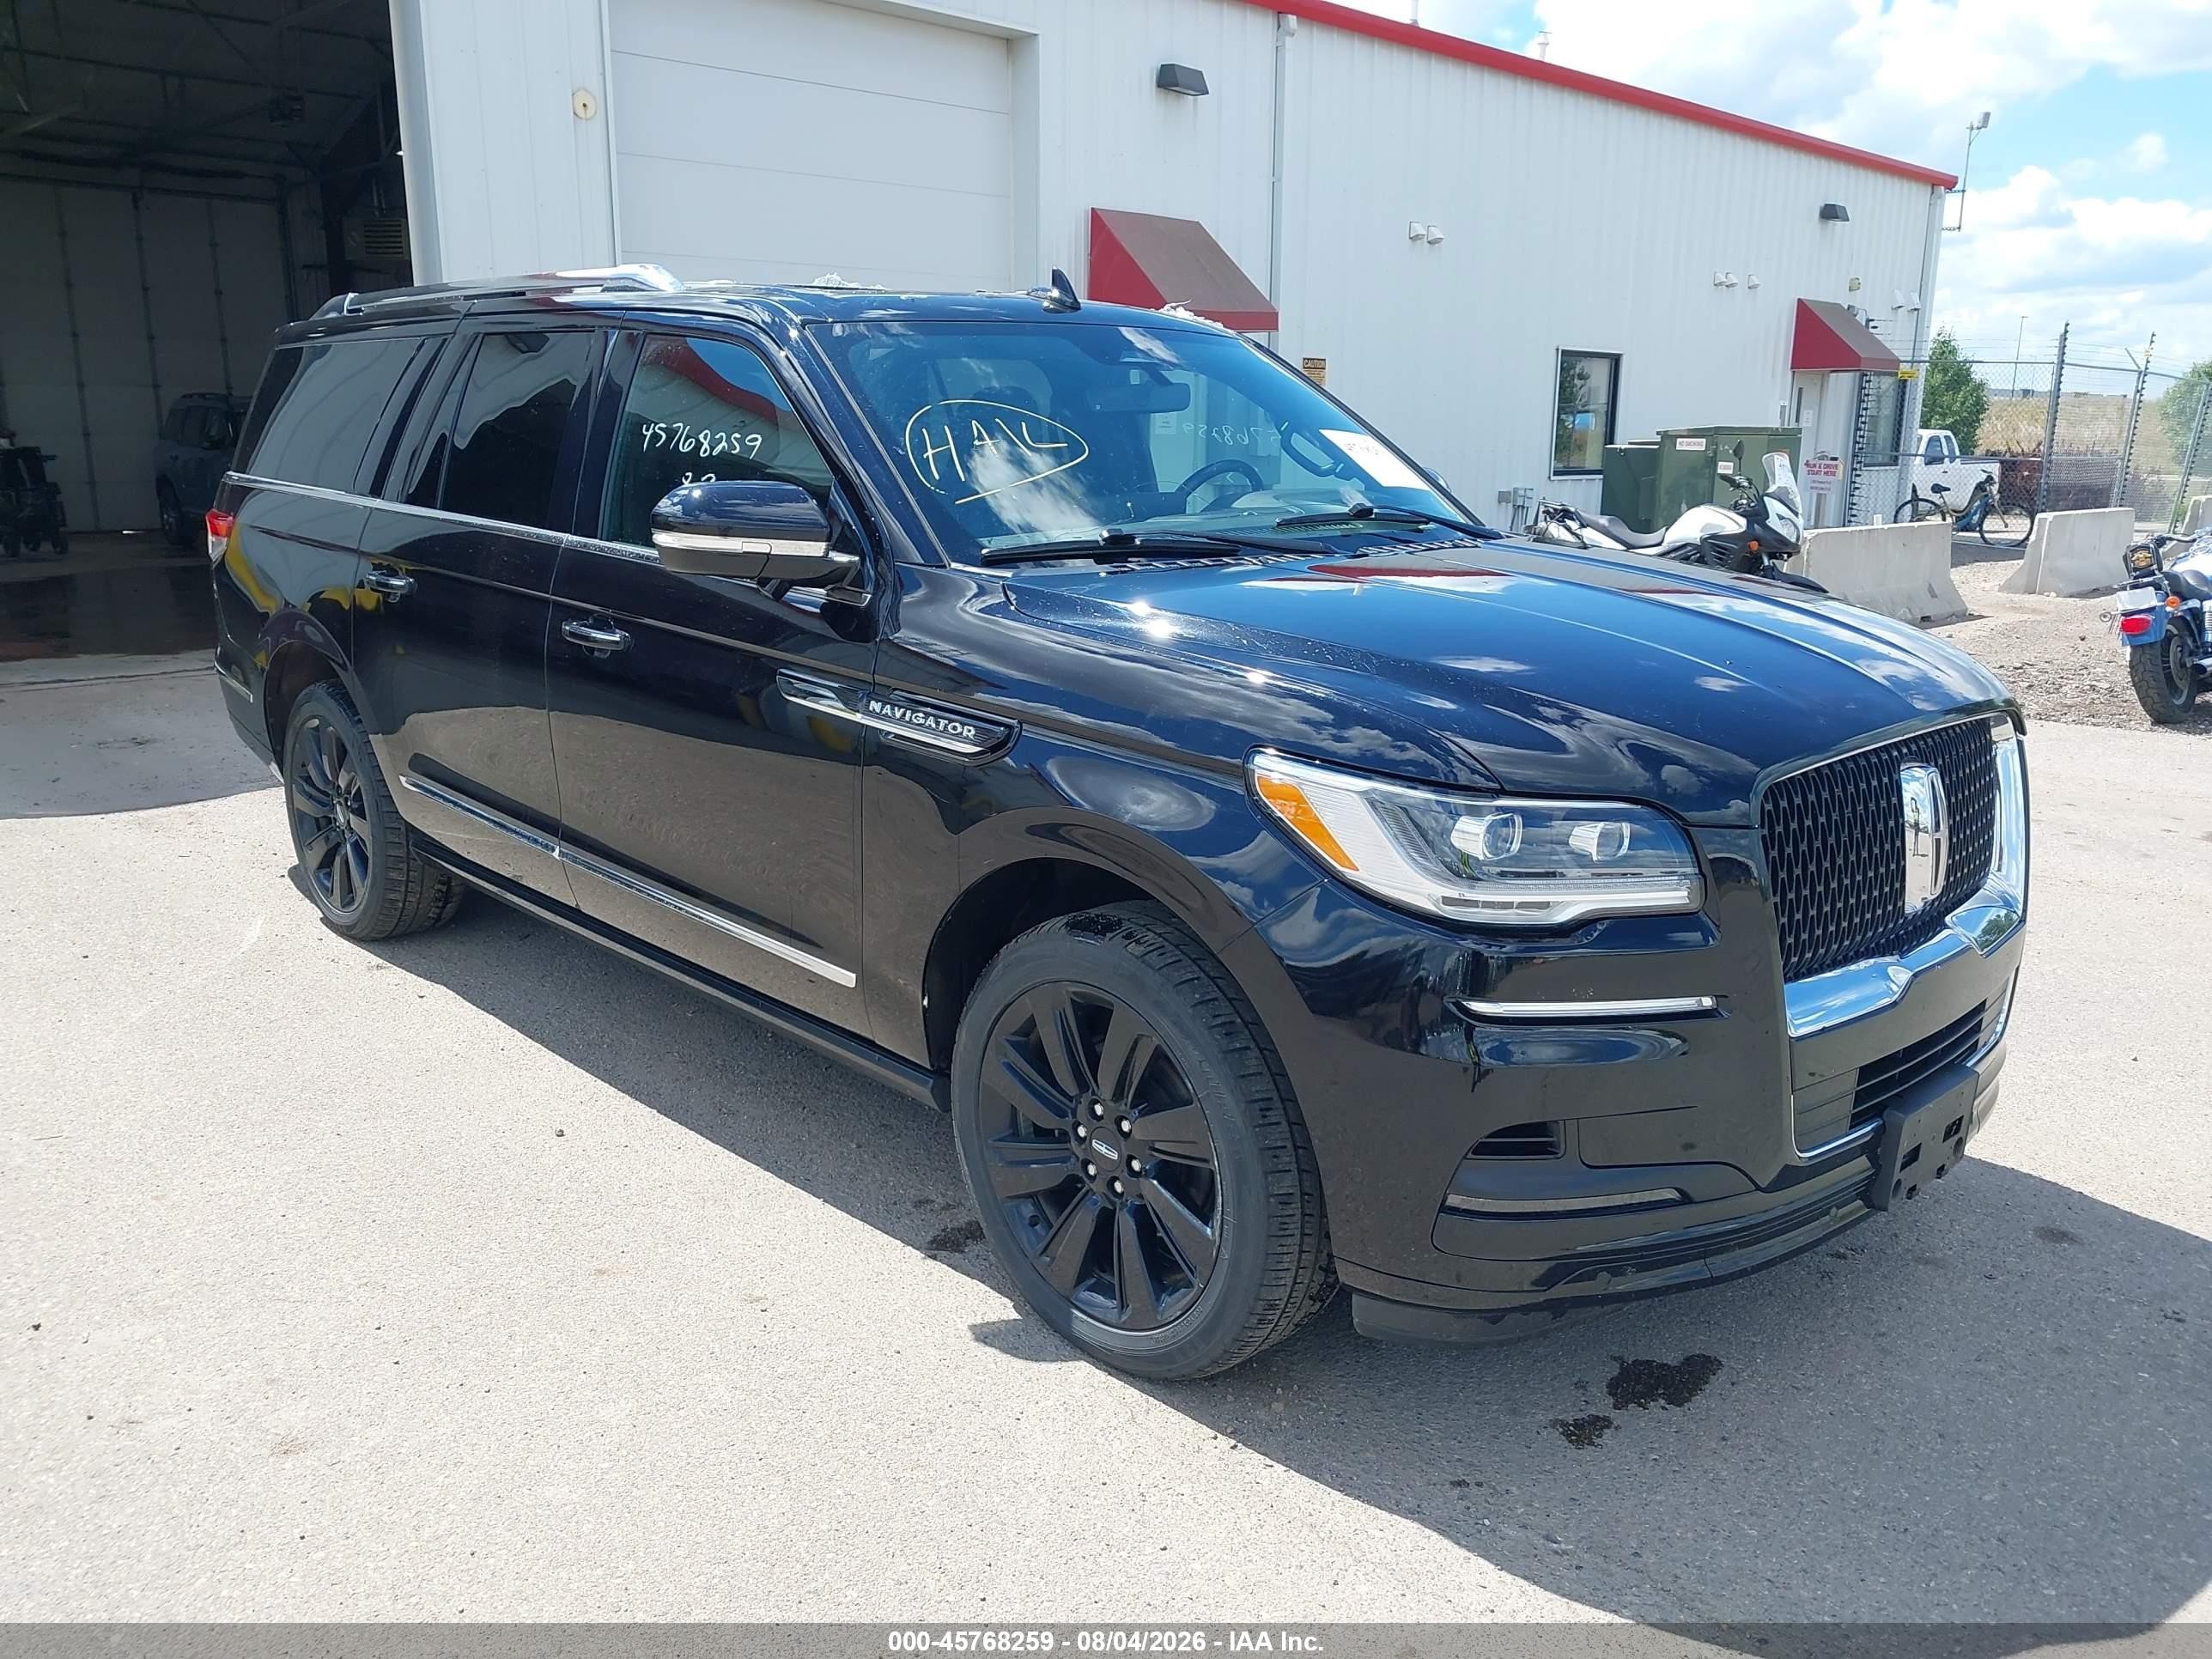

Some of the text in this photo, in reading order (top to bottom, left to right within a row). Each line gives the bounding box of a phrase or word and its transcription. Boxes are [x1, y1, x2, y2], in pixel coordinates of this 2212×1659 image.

[1304, 359, 1325, 368] CAUTION
[642, 422, 763, 459] 45768259
[921, 417, 1068, 482] HAIL
[869, 700, 975, 739] NAVIGATOR
